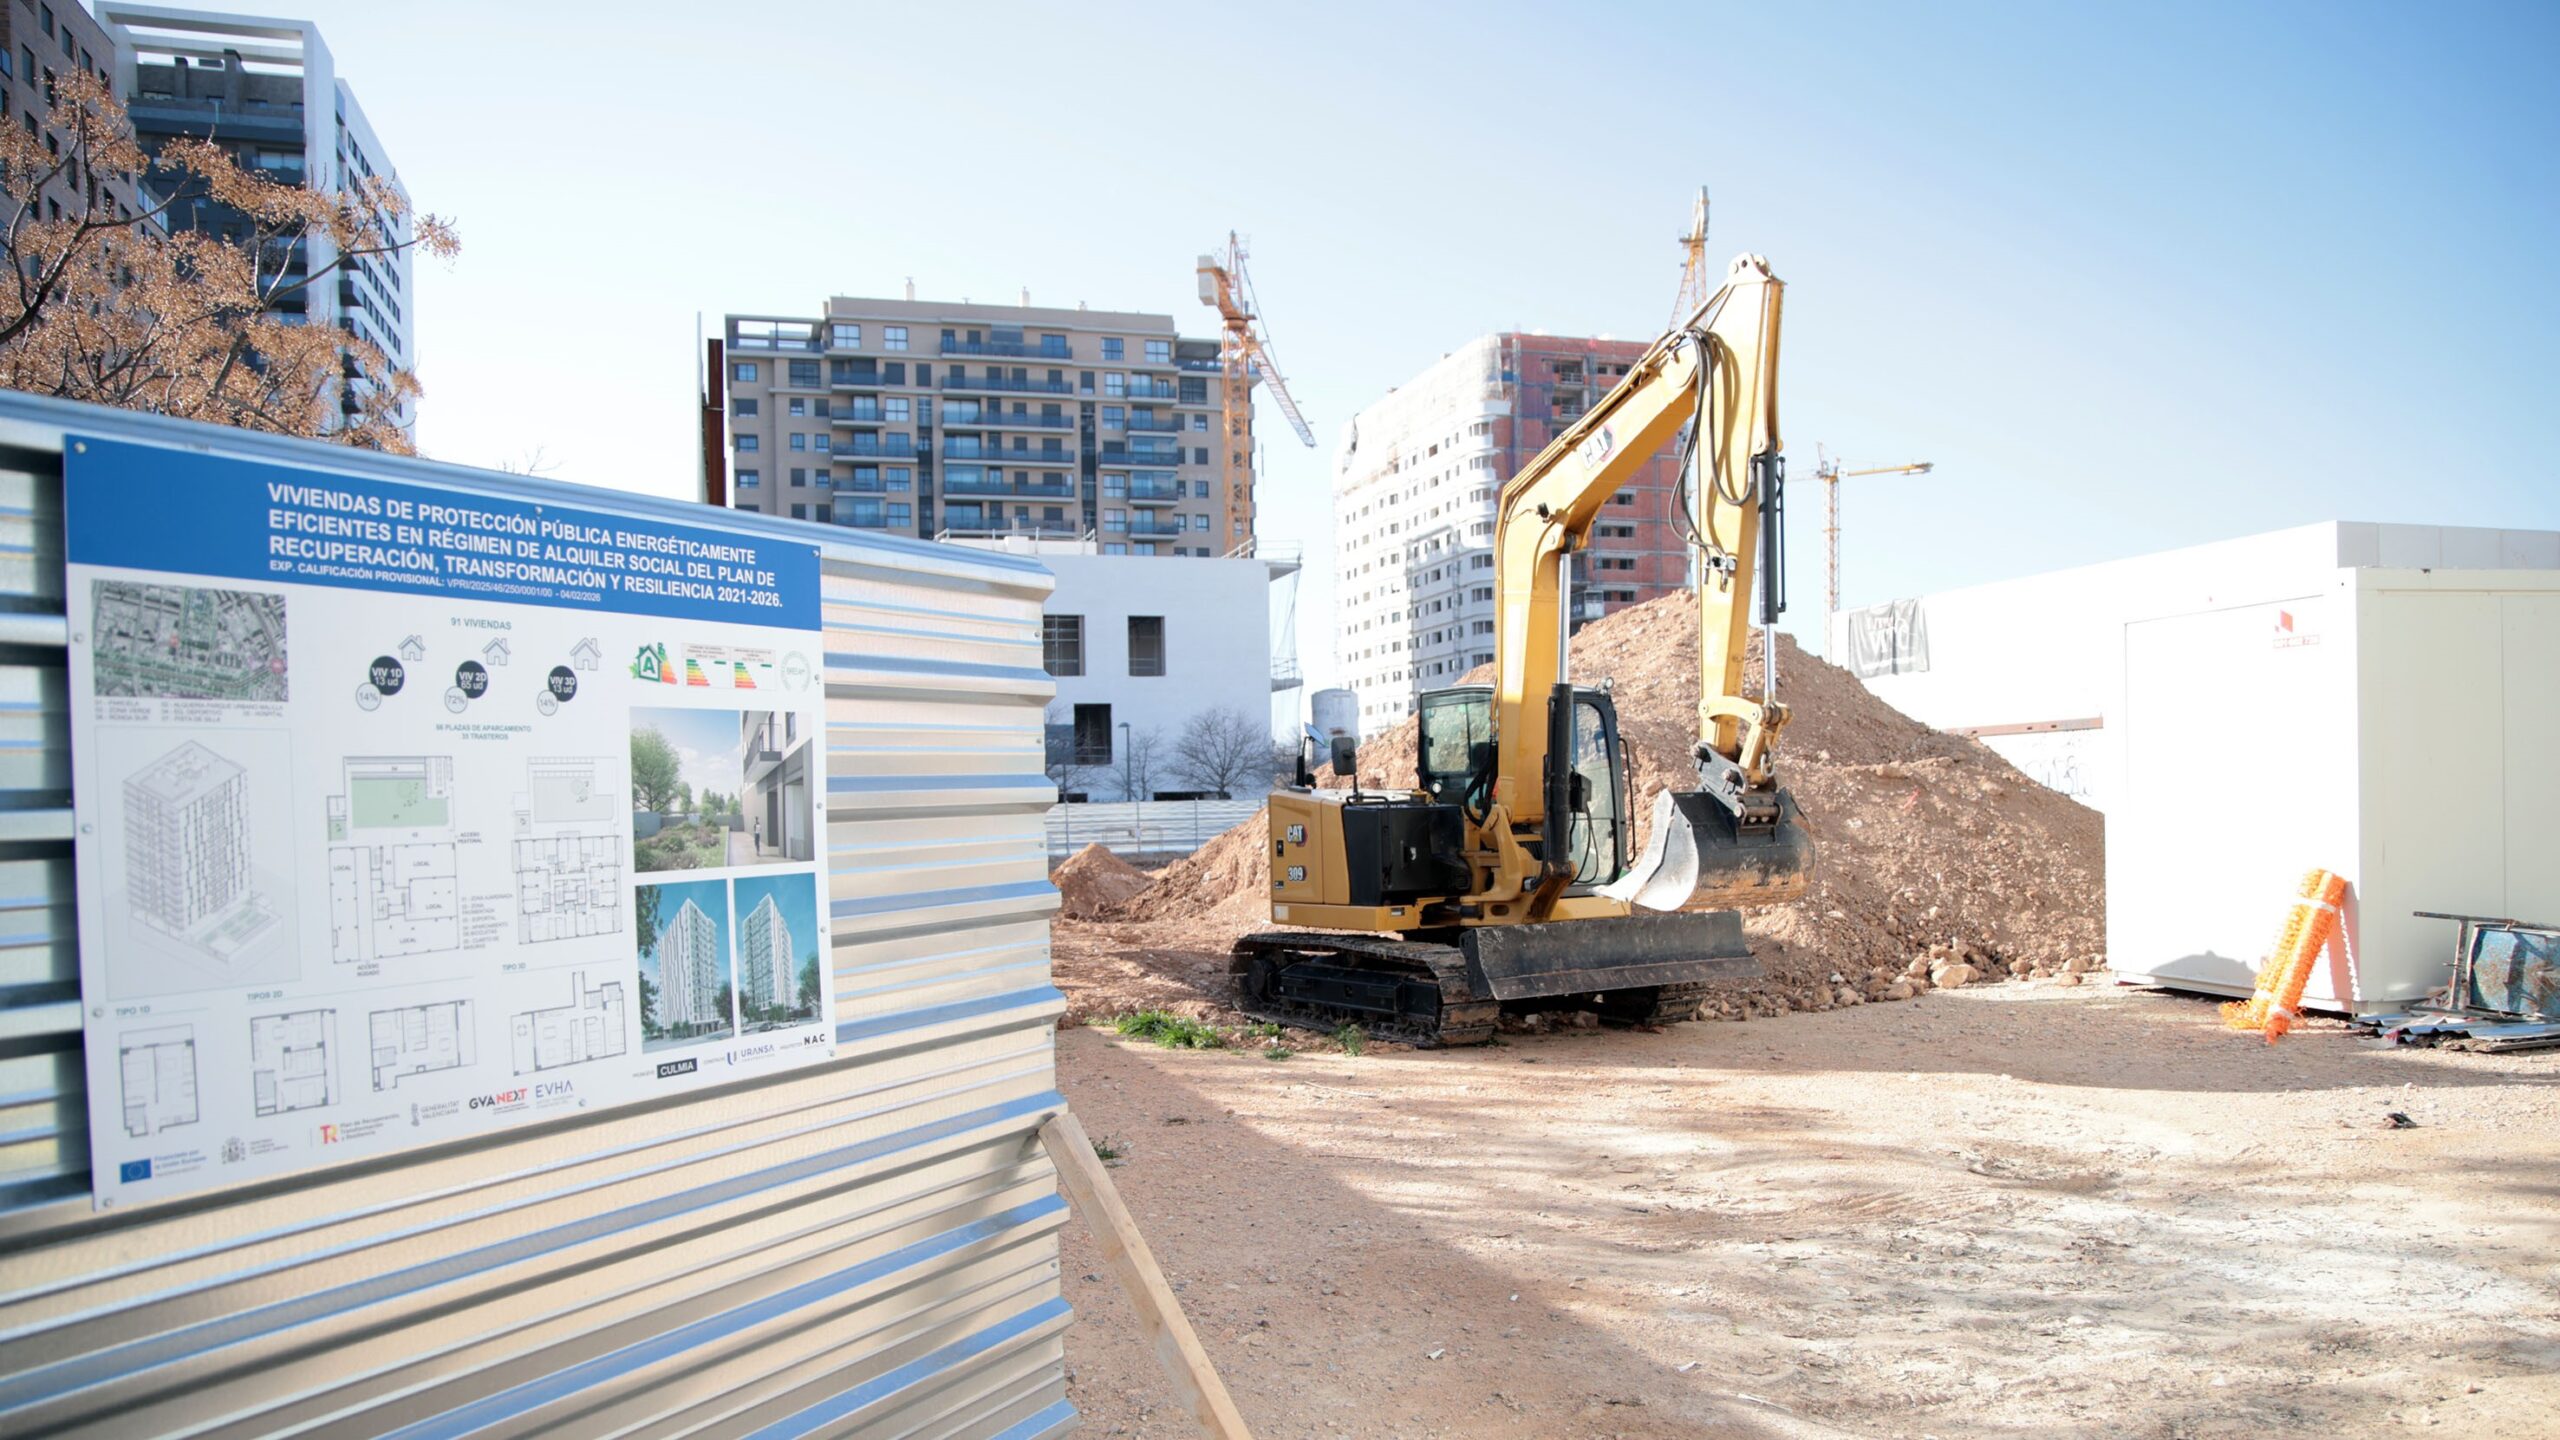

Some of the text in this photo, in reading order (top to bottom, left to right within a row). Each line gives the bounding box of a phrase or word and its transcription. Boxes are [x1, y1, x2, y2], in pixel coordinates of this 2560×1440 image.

[267, 482, 756, 565] VIVIENDAS DE PROTECCIÓN PÚBLICA ENERGÉTICAMENTE
[269, 509, 775, 587] EFICIENTES EN RÉGIMEN DE ALQUILER SOCIAL DEL PLAN DE
[269, 535, 783, 607] RECUPERACIÓN, TRANSFORMACIÓN Y RESILIENCIA 2021-2026.
[269, 560, 295, 572] EXP.
[298, 562, 372, 579] CALIFICACIÓN
[375, 570, 444, 587] PROVISIONAL:
[463, 618, 512, 630] VIVIENDAS
[642, 656, 655, 674] A
[371, 667, 402, 678] VIV 1D
[458, 672, 487, 682] VIV 2D
[375, 677, 398, 686] 13 ud
[473, 681, 484, 690] ud
[549, 676, 576, 686] VIV 3D
[563, 685, 573, 693] ud
[482, 724, 532, 733] APARCAMIENTO
[1287, 824, 1303, 843] CAT
[1288, 866, 1304, 881] 309
[116, 1007, 137, 1017] TIPO
[803, 1033, 825, 1045] NAC
[741, 1044, 775, 1057] URANSA
[660, 1061, 694, 1076] CULMIA
